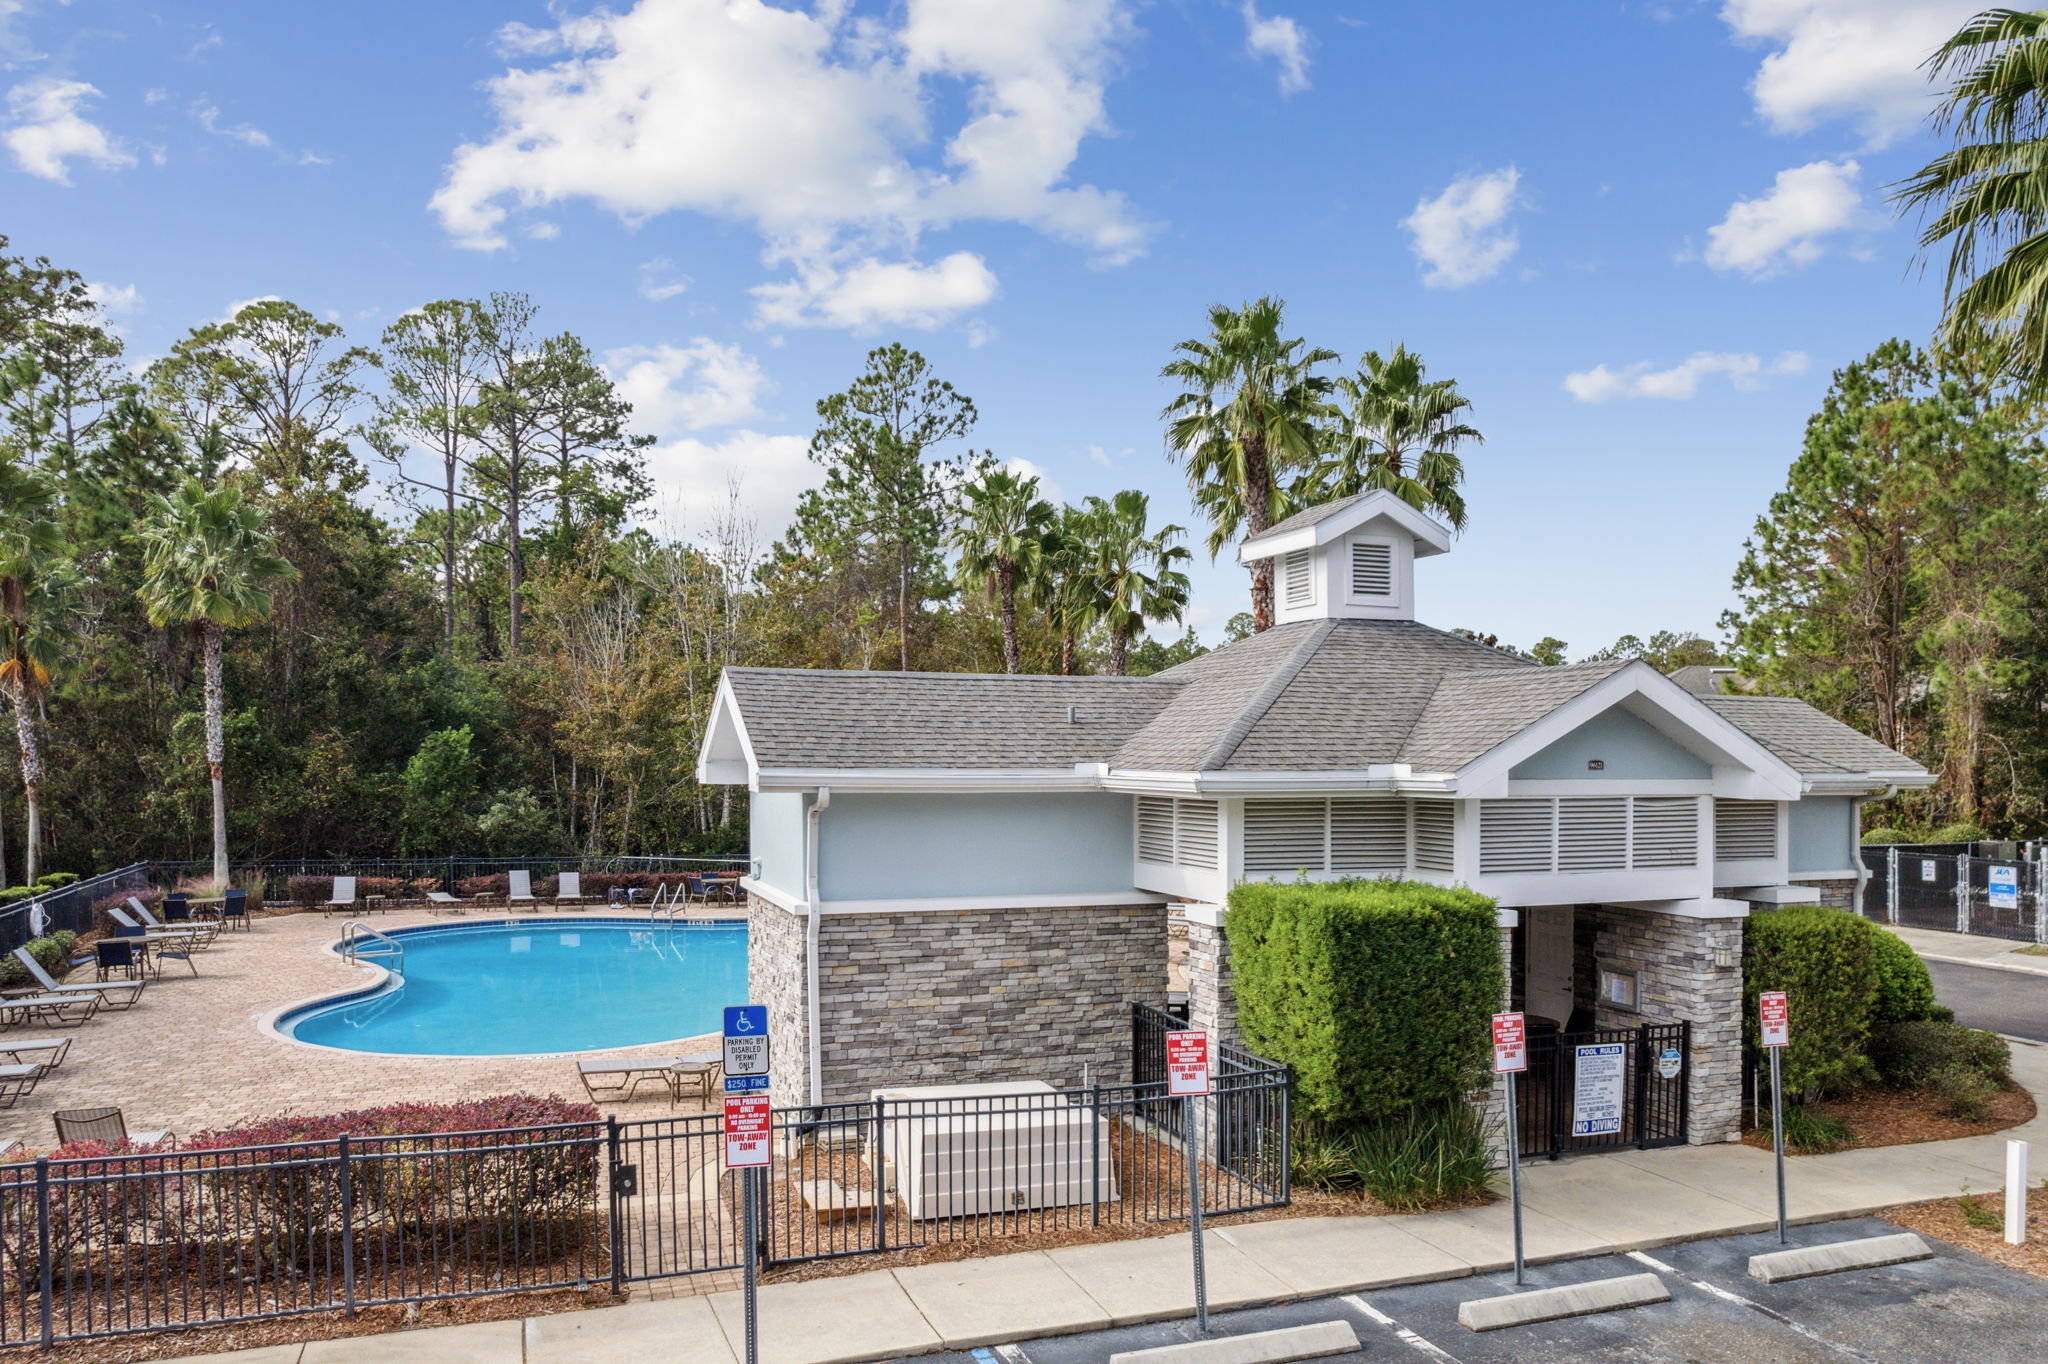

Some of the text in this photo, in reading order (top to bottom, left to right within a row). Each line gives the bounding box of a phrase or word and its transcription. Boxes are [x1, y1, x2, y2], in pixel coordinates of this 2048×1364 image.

[728, 1038, 754, 1046] PARKING
[1171, 1064, 1206, 1072] TOW-AWAY
[728, 1078, 767, 1088] $250 FINE
[742, 1098, 768, 1106] PARKING
[1576, 1118, 1618, 1133] NO DIVING
[728, 1132, 768, 1142] TOW-AWAY
[739, 1142, 756, 1151] ZONE
